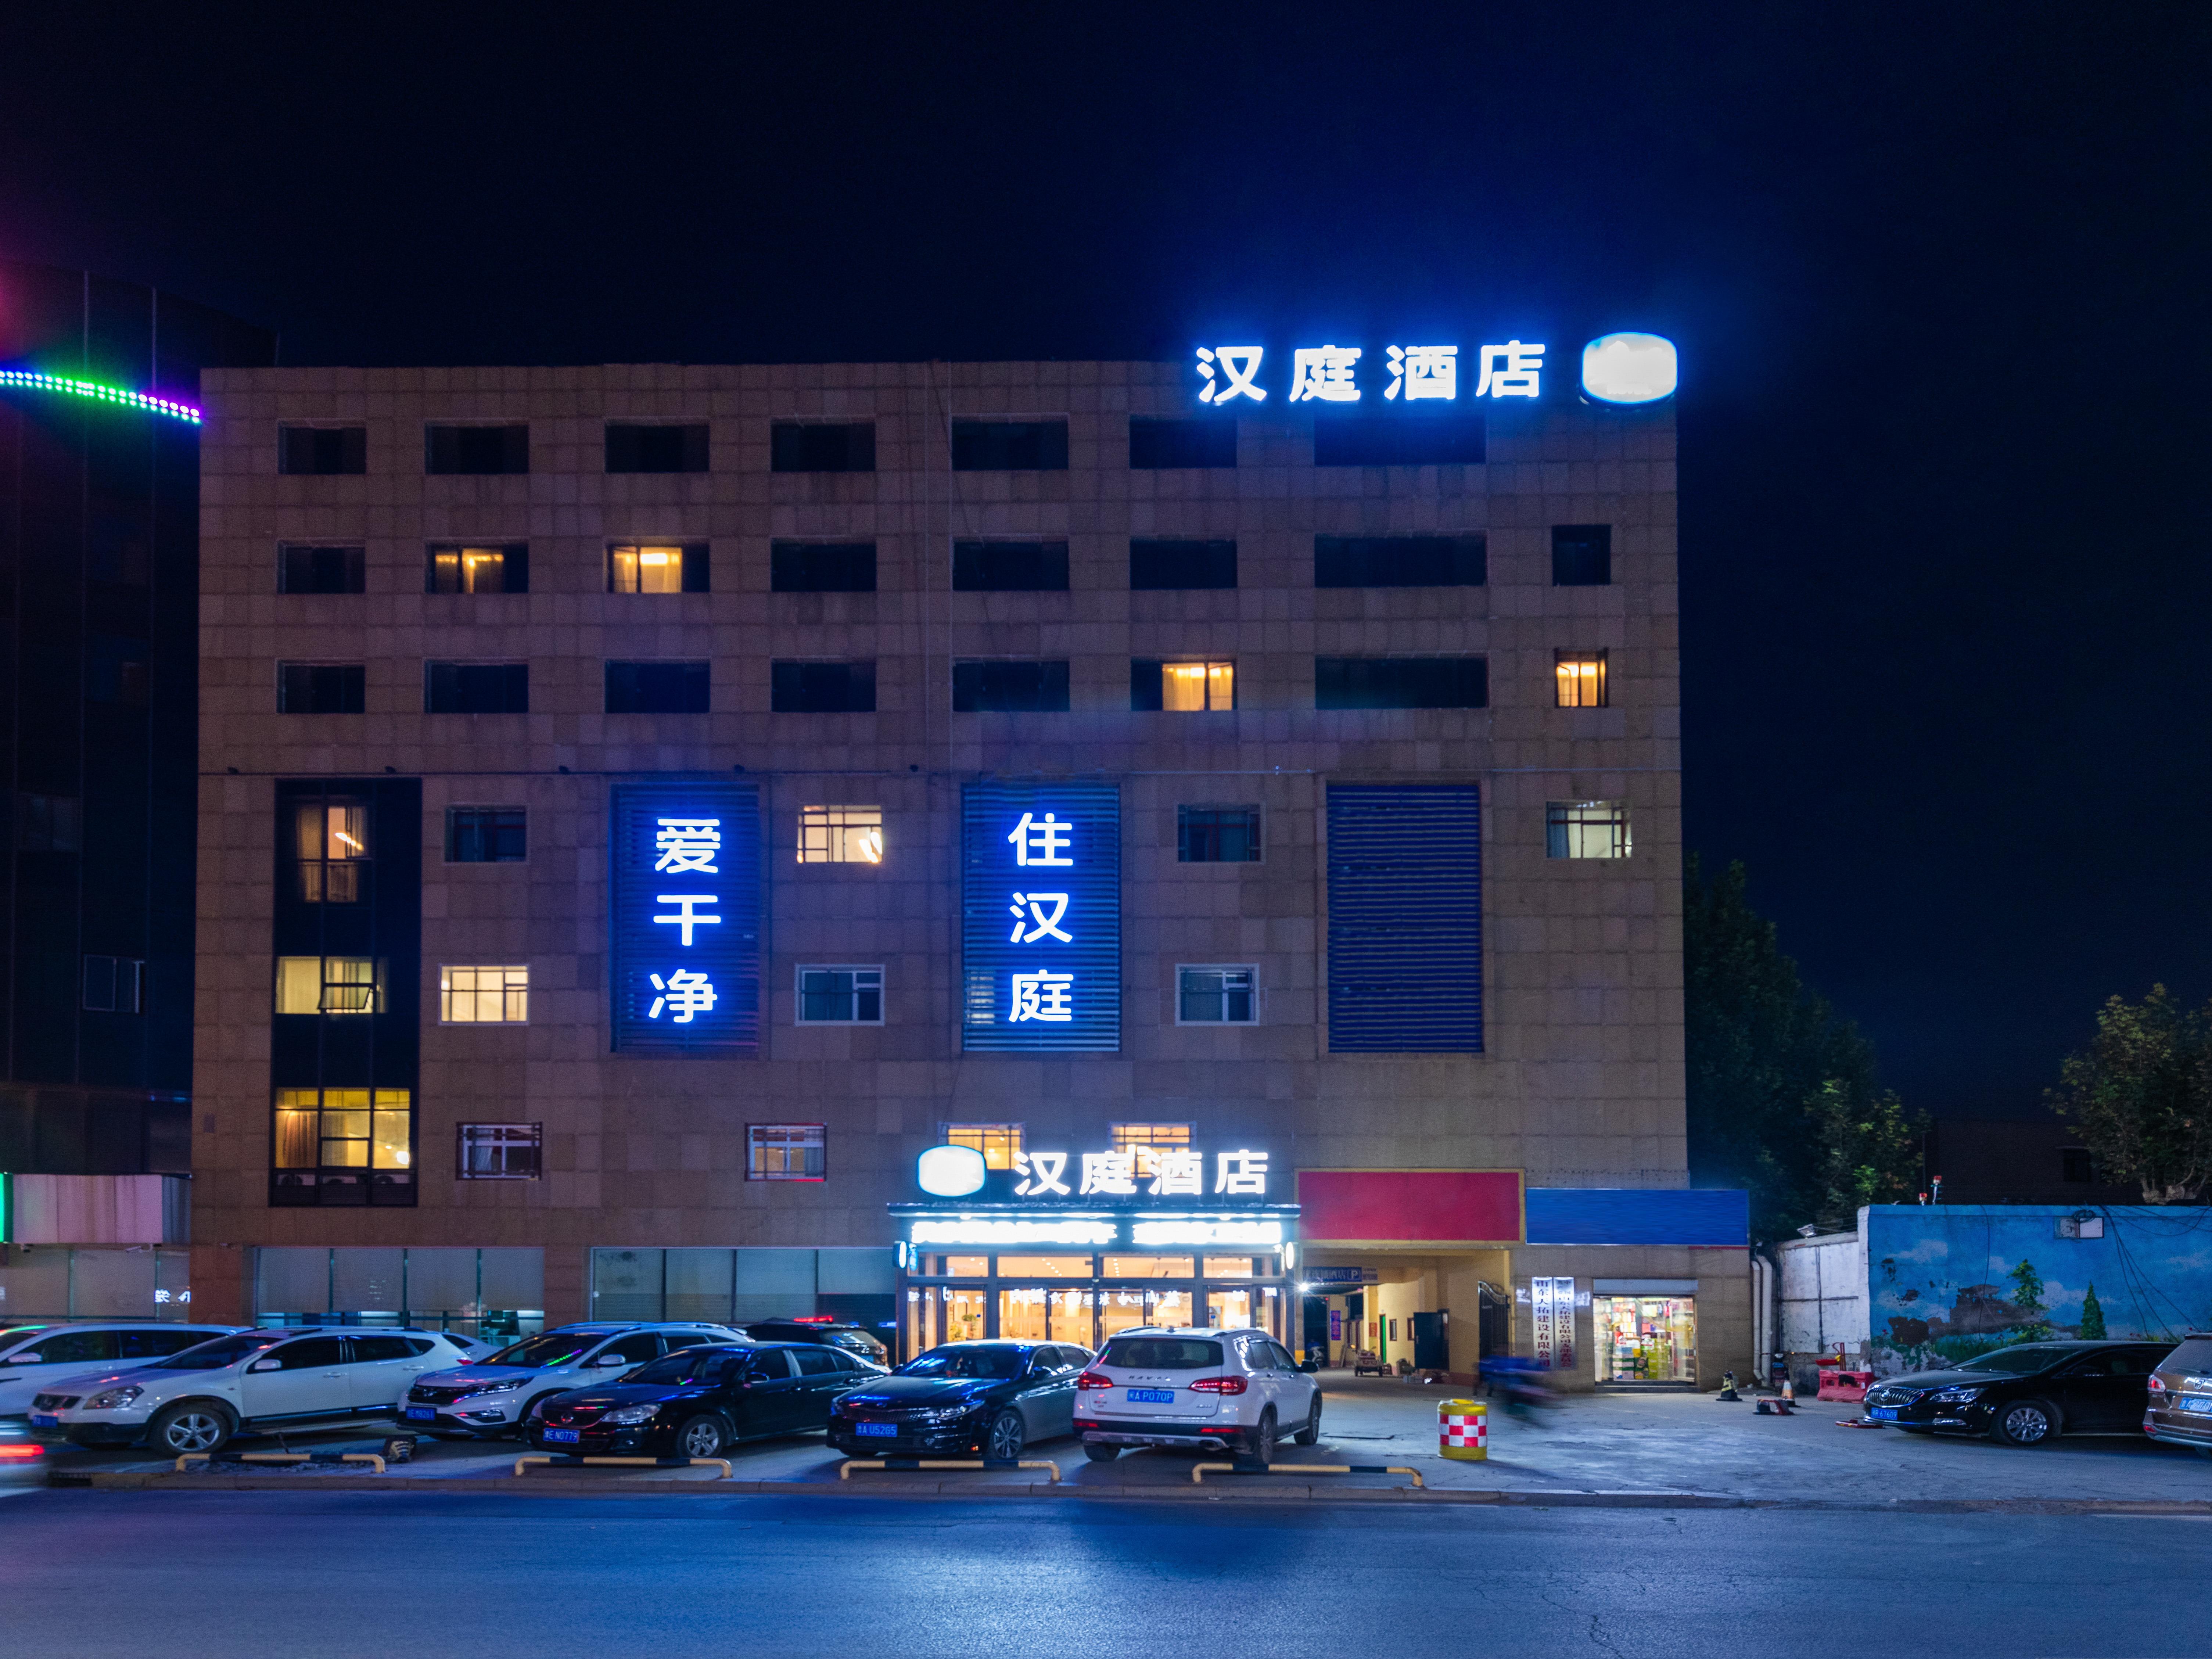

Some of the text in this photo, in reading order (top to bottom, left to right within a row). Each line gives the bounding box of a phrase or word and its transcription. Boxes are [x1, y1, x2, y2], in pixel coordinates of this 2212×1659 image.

[1196, 340, 1545, 403] 汉庭酒店
[649, 819, 721, 1023] 爱干净
[1008, 813, 1073, 1022] 住汉庭
[1013, 1149, 1268, 1195] 汉庭酒店
